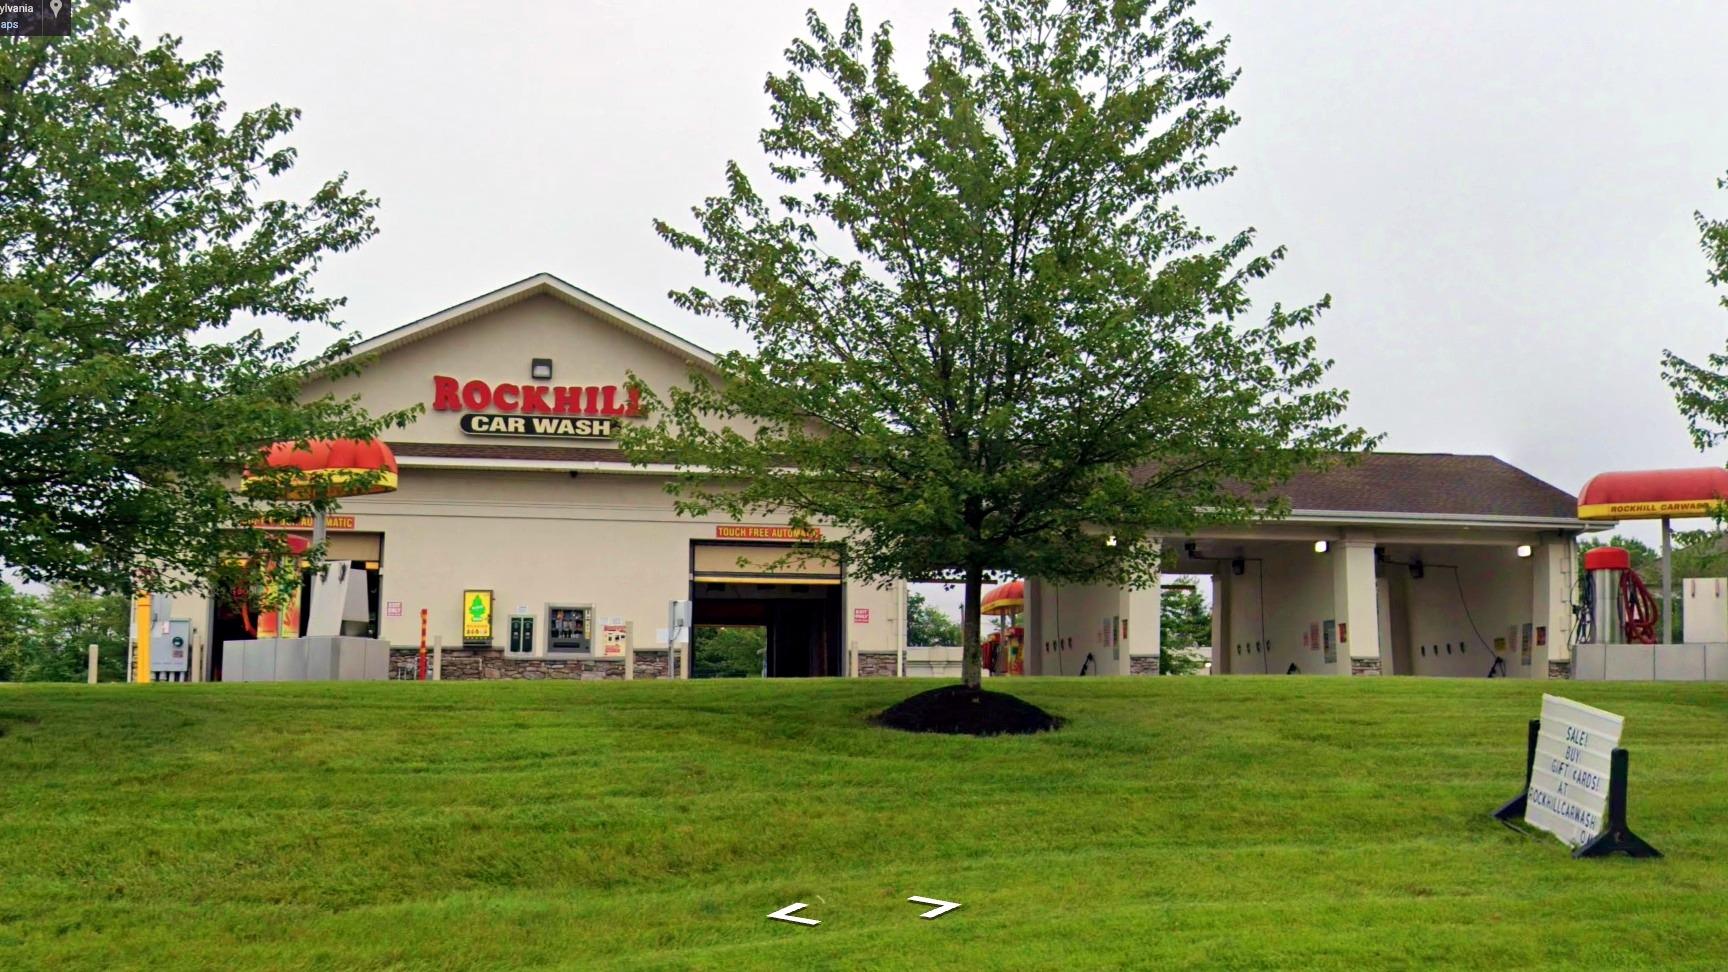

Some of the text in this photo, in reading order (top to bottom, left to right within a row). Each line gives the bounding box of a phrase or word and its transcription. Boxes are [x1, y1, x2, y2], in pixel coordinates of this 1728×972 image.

[433, 375, 648, 418] ROCKHILL
[471, 416, 610, 436] CAR WASH
[1611, 505, 1657, 513] ROCKHILL
[301, 517, 353, 527] AUMATIC
[719, 527, 819, 538] TOUCH FREE AUTOMA
[1566, 726, 1588, 747] SALE!
[1565, 745, 1580, 763] BUY
[1552, 759, 1568, 777] GIFT
[1557, 781, 1568, 797] AT
[1528, 787, 1597, 830] ROCKHILLCARWASH
